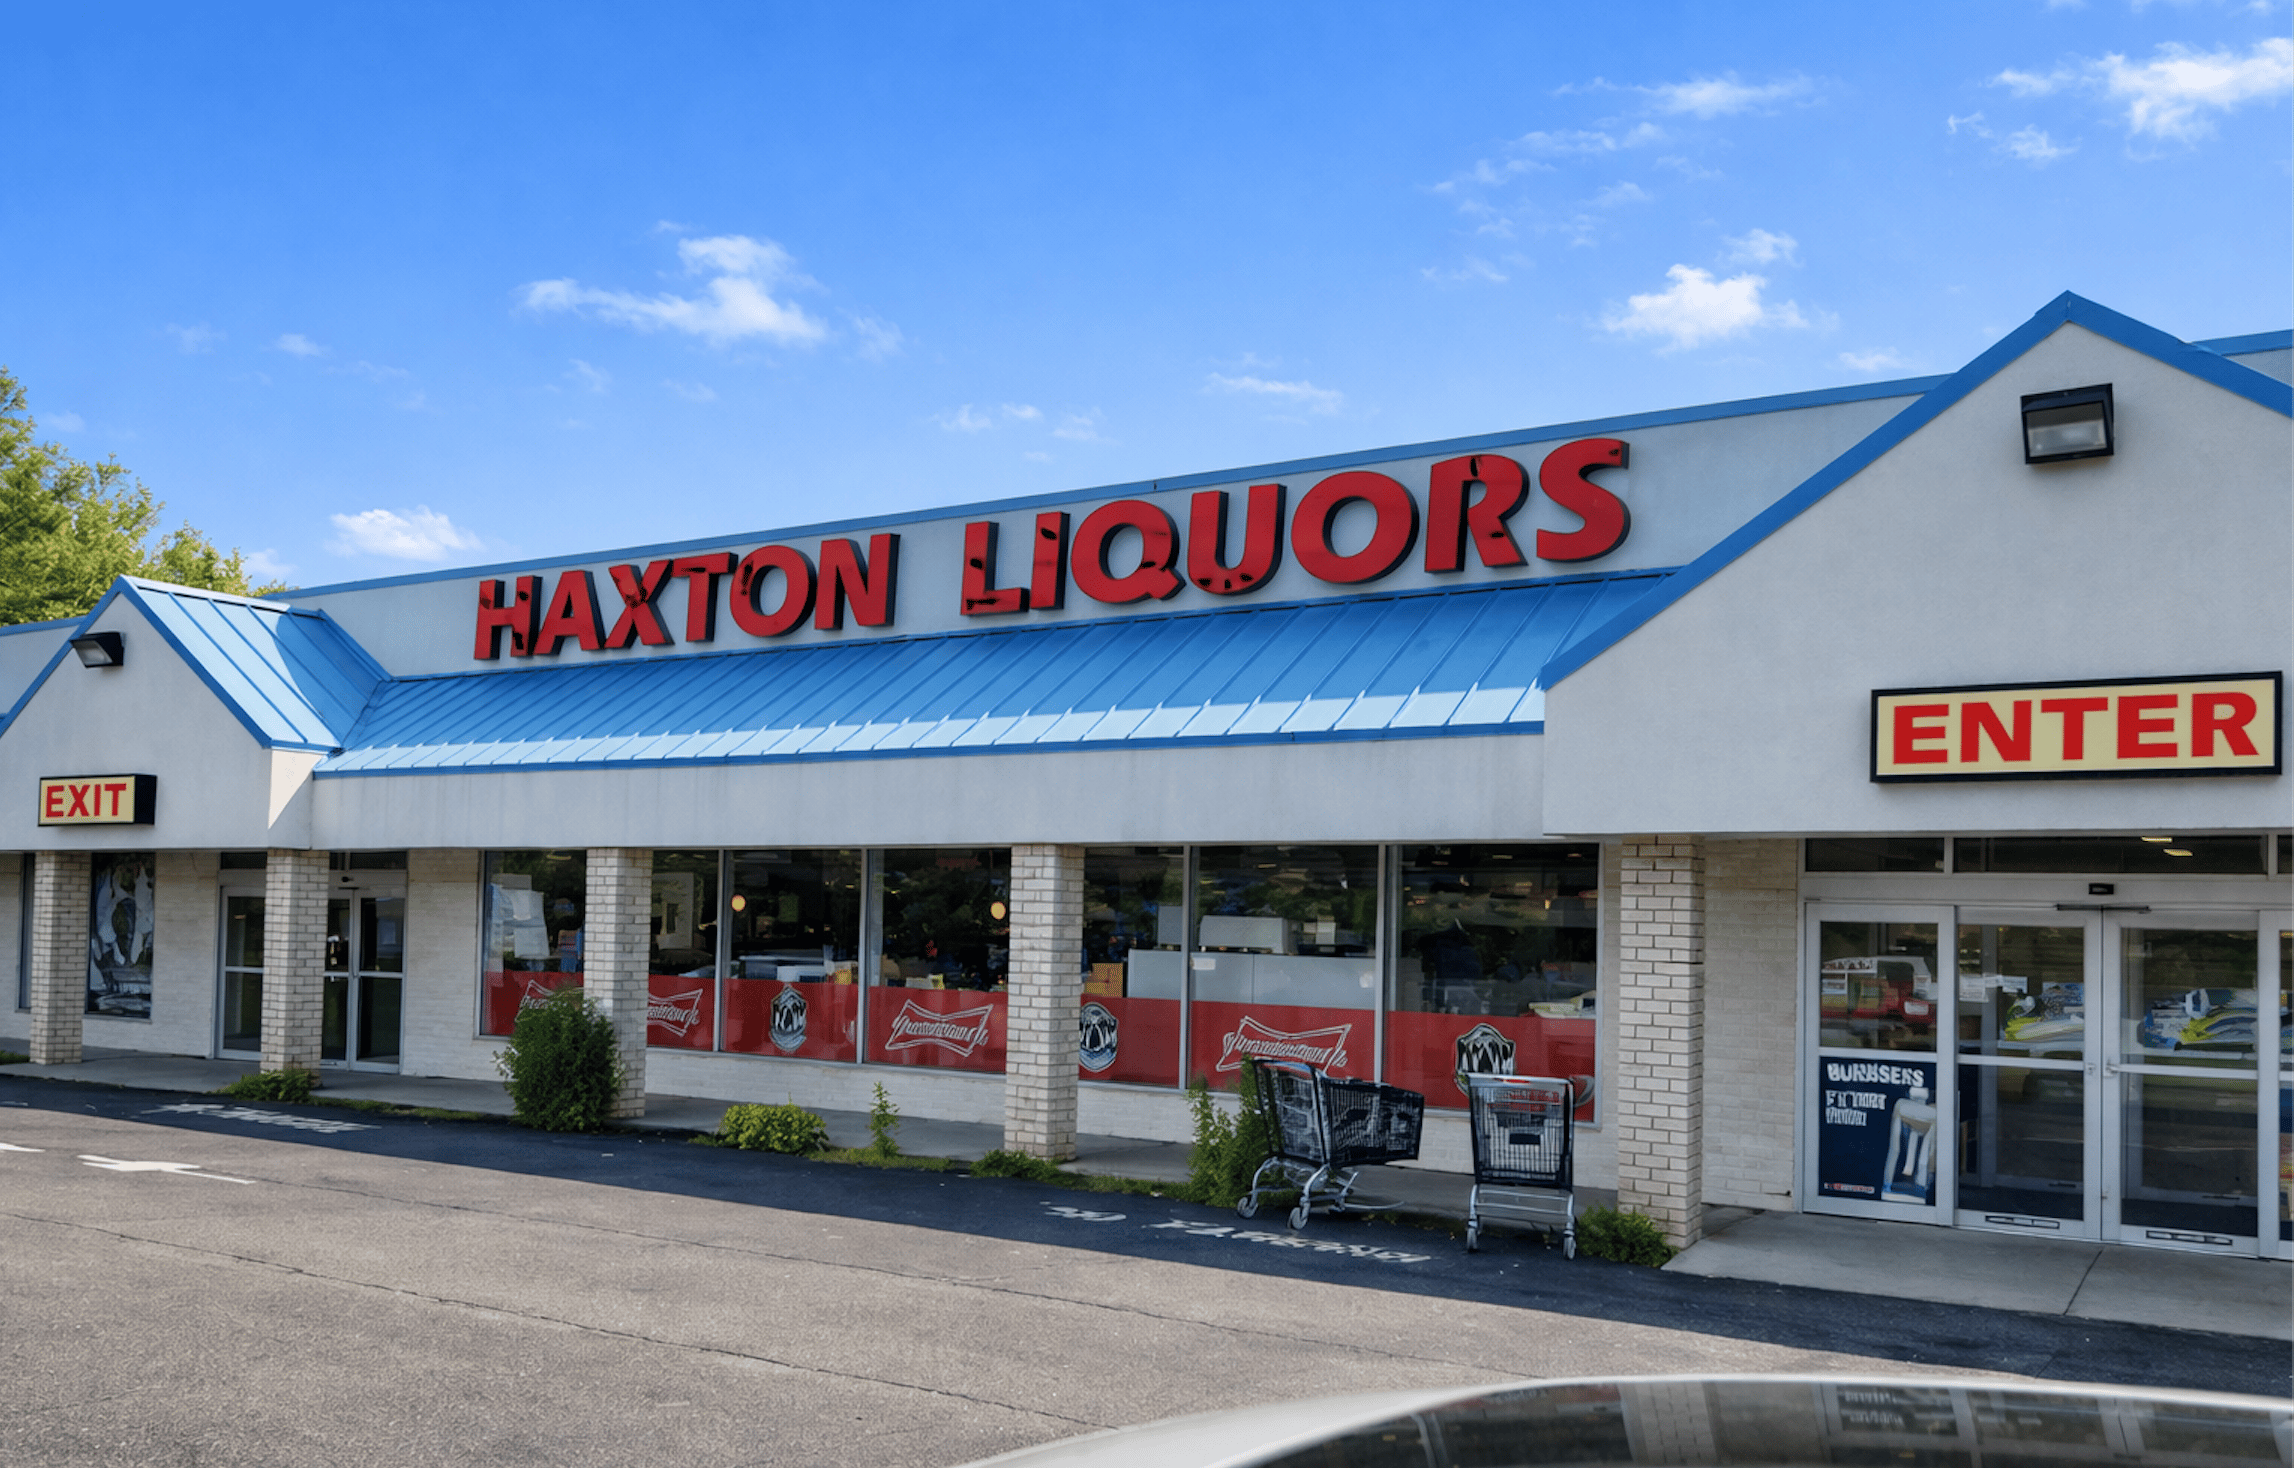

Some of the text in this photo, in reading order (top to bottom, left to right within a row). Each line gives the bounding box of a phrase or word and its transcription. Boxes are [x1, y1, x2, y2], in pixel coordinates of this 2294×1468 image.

[474, 438, 1631, 660] HAXTON LIQUORS
[1893, 692, 2258, 764] ENTER
[46, 783, 127, 818] EXIT
